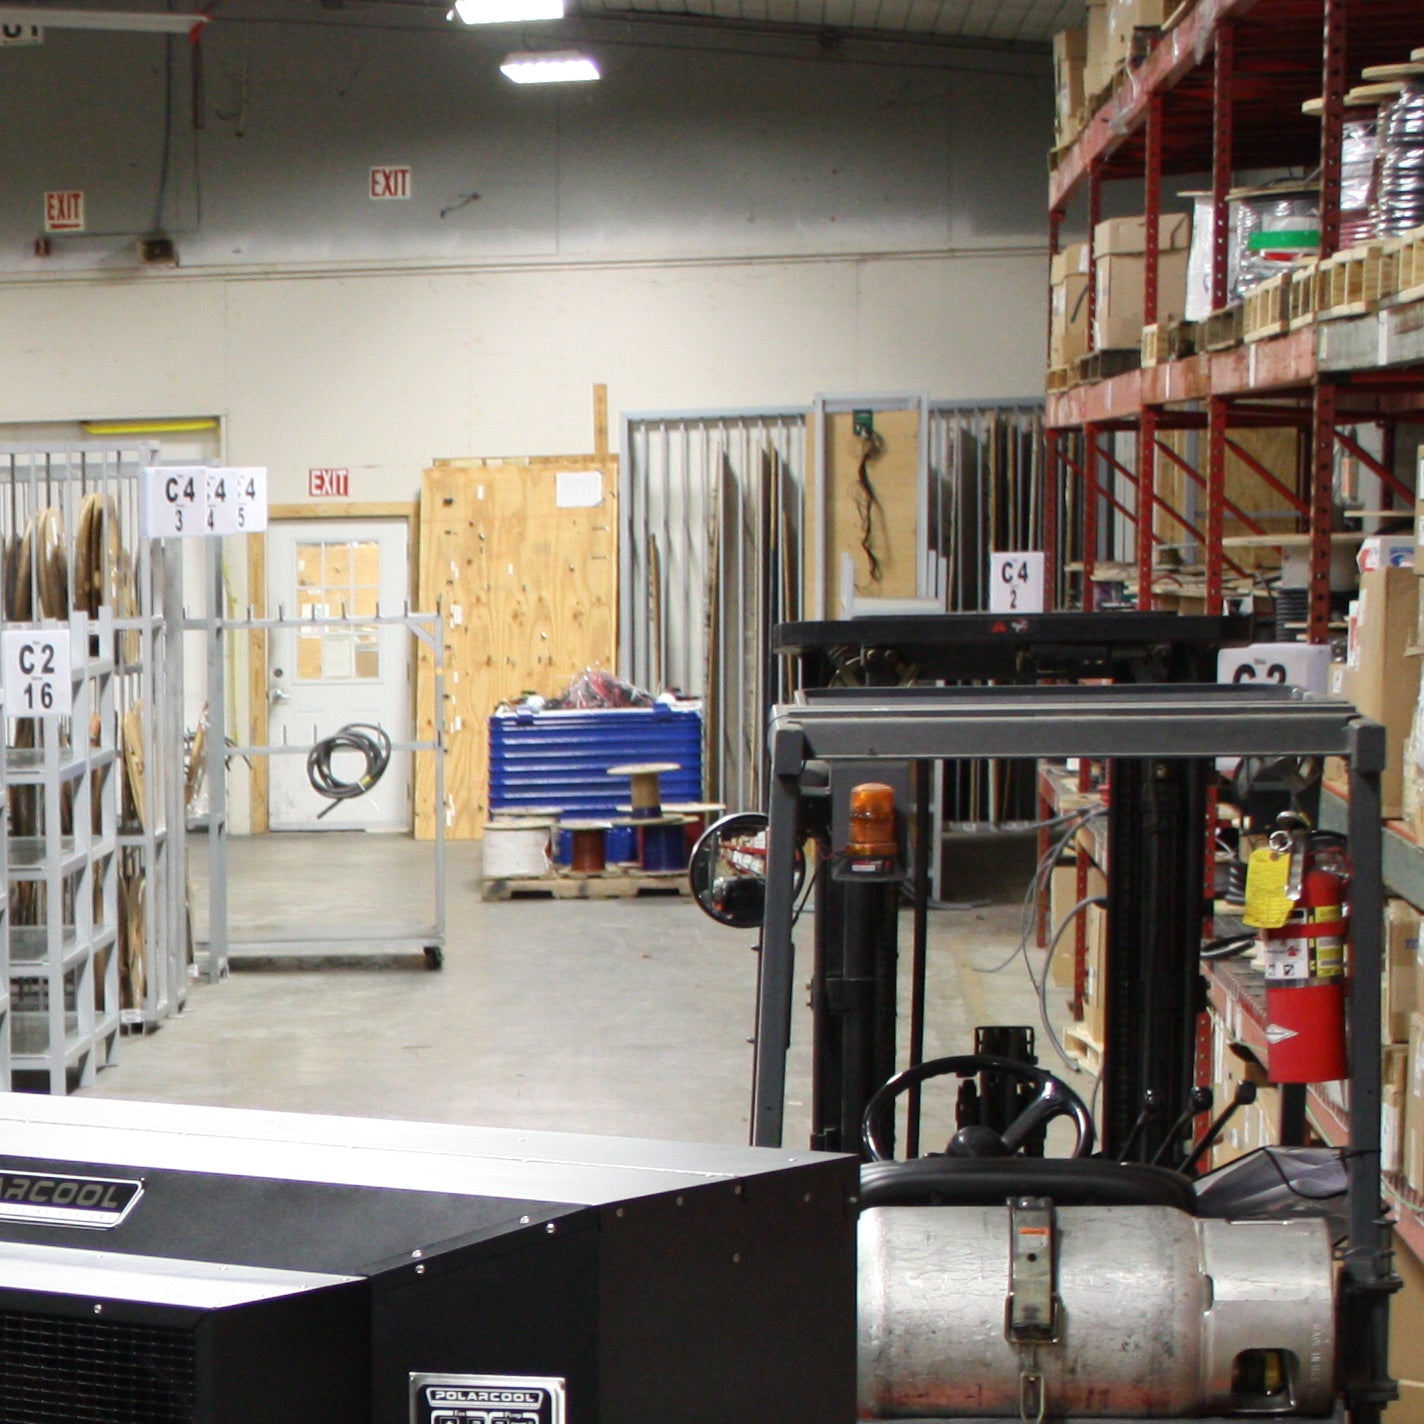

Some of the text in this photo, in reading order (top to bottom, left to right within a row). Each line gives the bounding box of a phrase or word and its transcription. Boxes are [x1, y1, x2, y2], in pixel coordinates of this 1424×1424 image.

[370, 168, 409, 197] EXIT
[46, 193, 82, 221] EXIT
[310, 469, 348, 496] EXIT
[175, 509, 183, 532] 3
[207, 509, 215, 531] 4
[238, 507, 246, 528] 5
[1009, 588, 1018, 610] 2
[23, 682, 53, 709] 16
[434, 1390, 536, 1402] POLARCOOL
